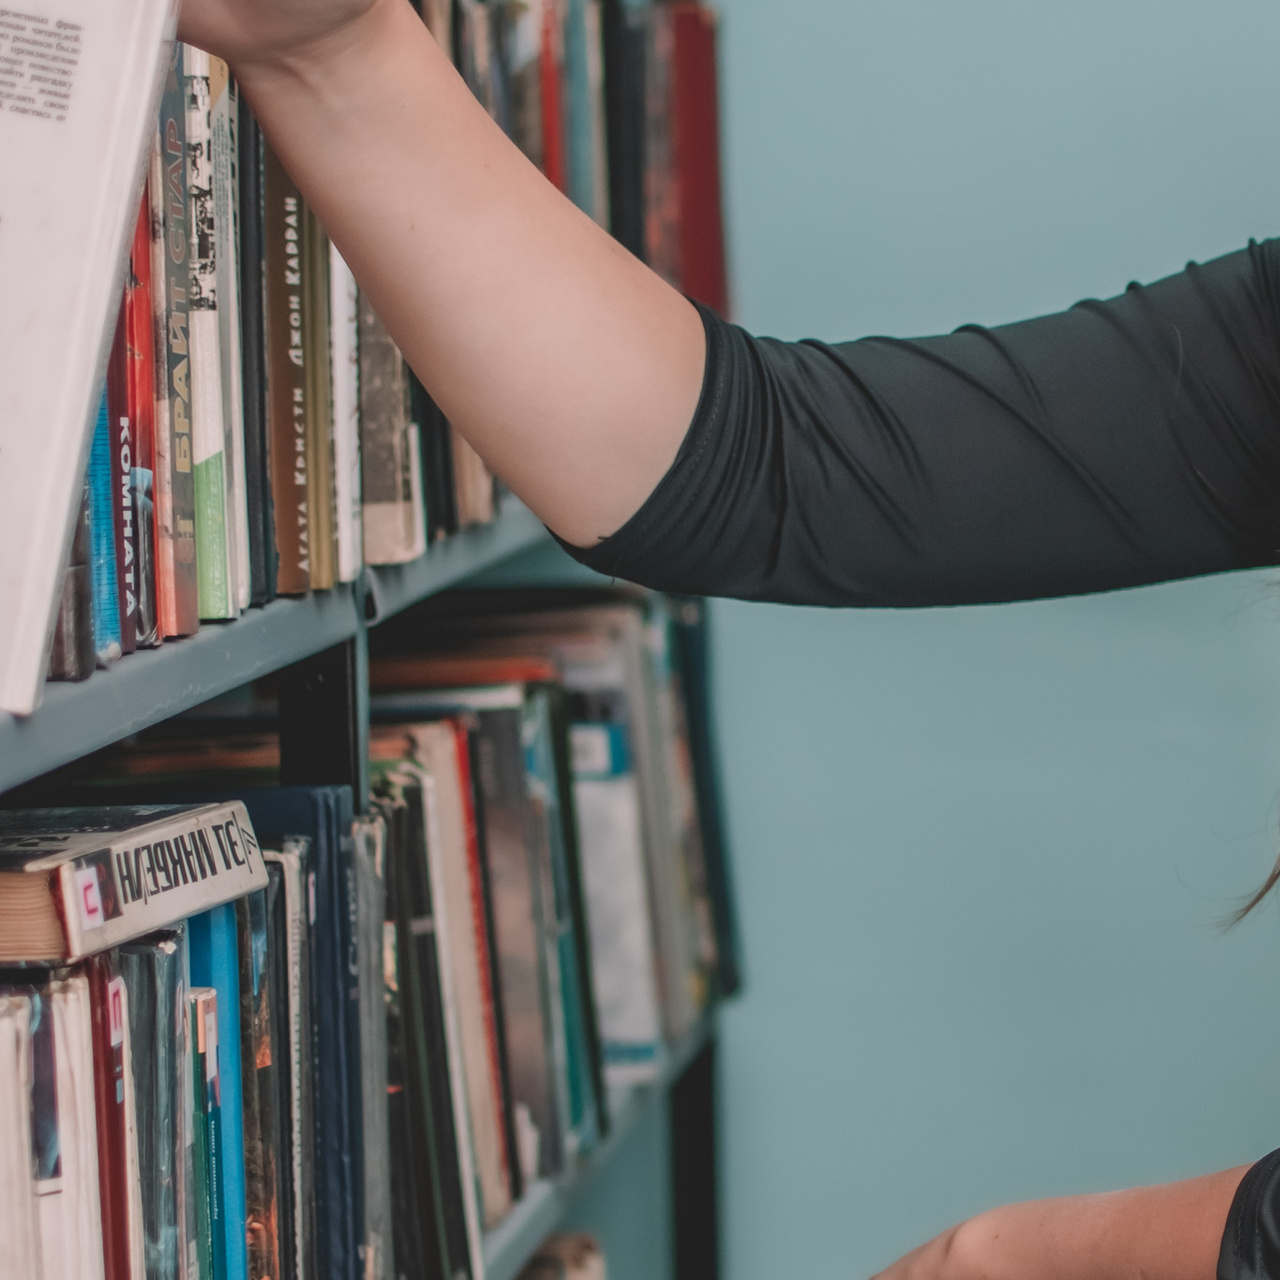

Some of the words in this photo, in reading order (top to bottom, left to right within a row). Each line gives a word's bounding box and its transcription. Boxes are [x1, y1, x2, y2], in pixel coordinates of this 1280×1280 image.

[0, 9, 49, 25] ременных
[166, 116, 187, 265] СТАР
[284, 196, 301, 286] КАРРАН
[171, 276, 192, 475] БРАЙТ
[288, 294, 305, 368] ДЖОН
[293, 387, 307, 486] КРИСТИ
[119, 416, 138, 618] КОМНАТА
[297, 501, 311, 572] АГАТА
[212, 820, 245, 870] ЭД
